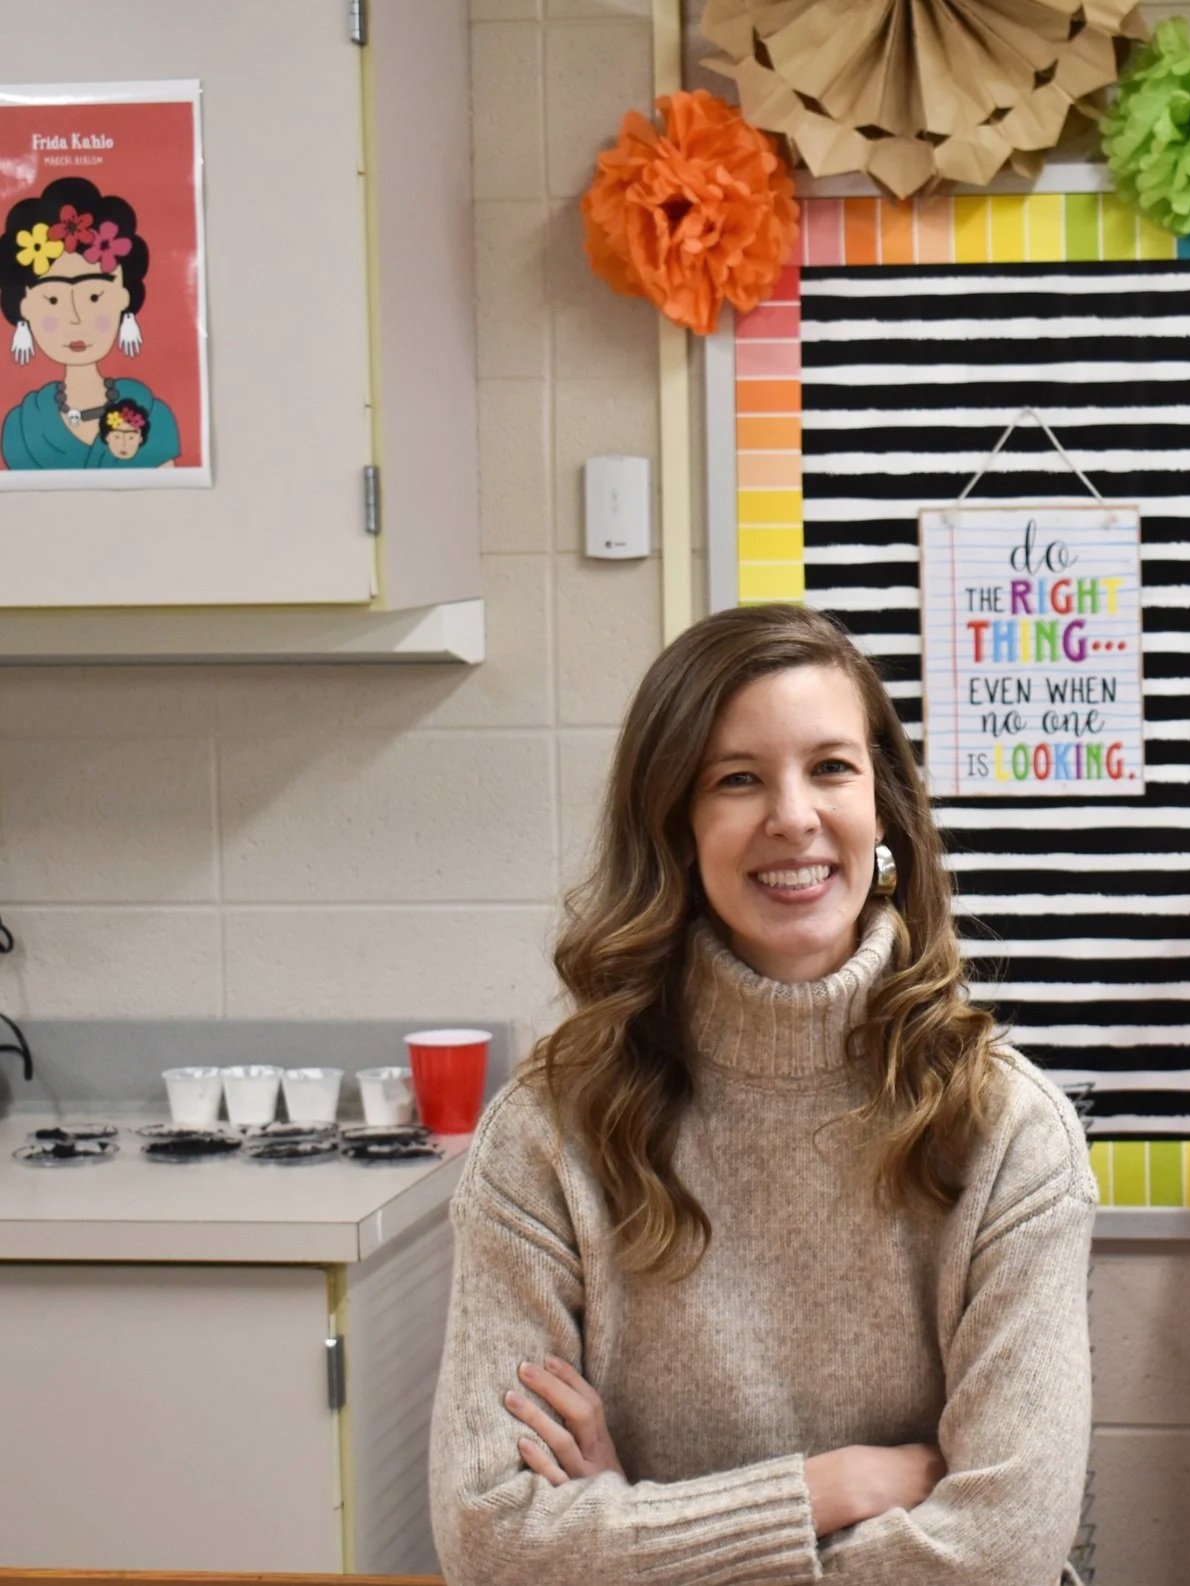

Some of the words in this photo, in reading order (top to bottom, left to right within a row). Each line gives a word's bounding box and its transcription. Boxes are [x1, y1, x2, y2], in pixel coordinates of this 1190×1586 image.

[32, 132, 69, 150] Frida
[71, 132, 114, 149] Kahlo
[1010, 518, 1078, 576] do
[965, 586, 1004, 613] THE
[1010, 577, 1124, 615] RIGHT
[966, 619, 1127, 663] THING...
[969, 677, 1031, 704] EVEN
[1046, 677, 1117, 704] WHEN
[981, 709, 1028, 736] no
[1042, 708, 1105, 737] one
[967, 753, 989, 777] IS
[994, 742, 1136, 781] LOOKING.
